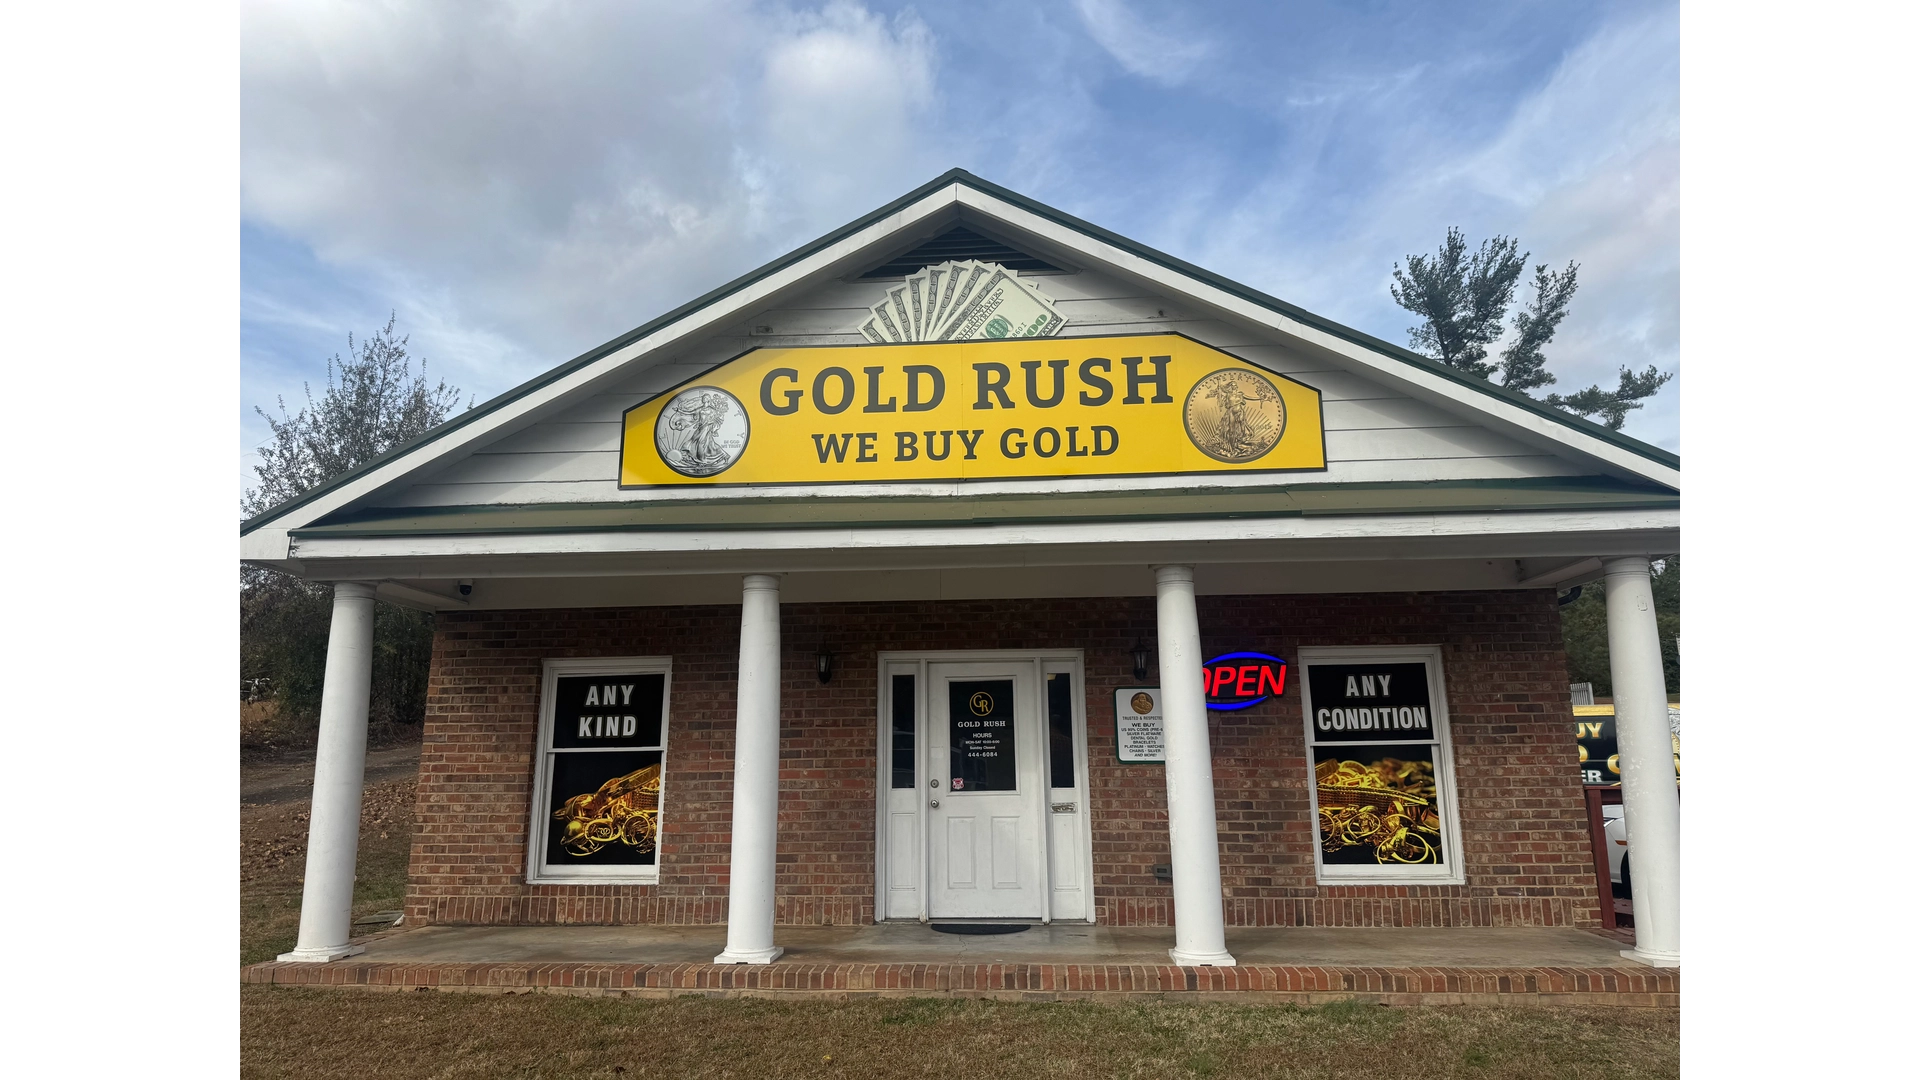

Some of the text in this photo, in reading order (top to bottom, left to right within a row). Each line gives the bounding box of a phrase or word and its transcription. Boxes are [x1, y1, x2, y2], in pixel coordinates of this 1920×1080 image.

[759, 355, 1173, 415] GOLD RUSH
[812, 425, 1120, 463] WE BUY GOLD
[585, 685, 634, 706] ANY
[1346, 675, 1391, 696] ANY
[578, 716, 636, 737] KIND
[1317, 707, 1428, 731] CONDITION
